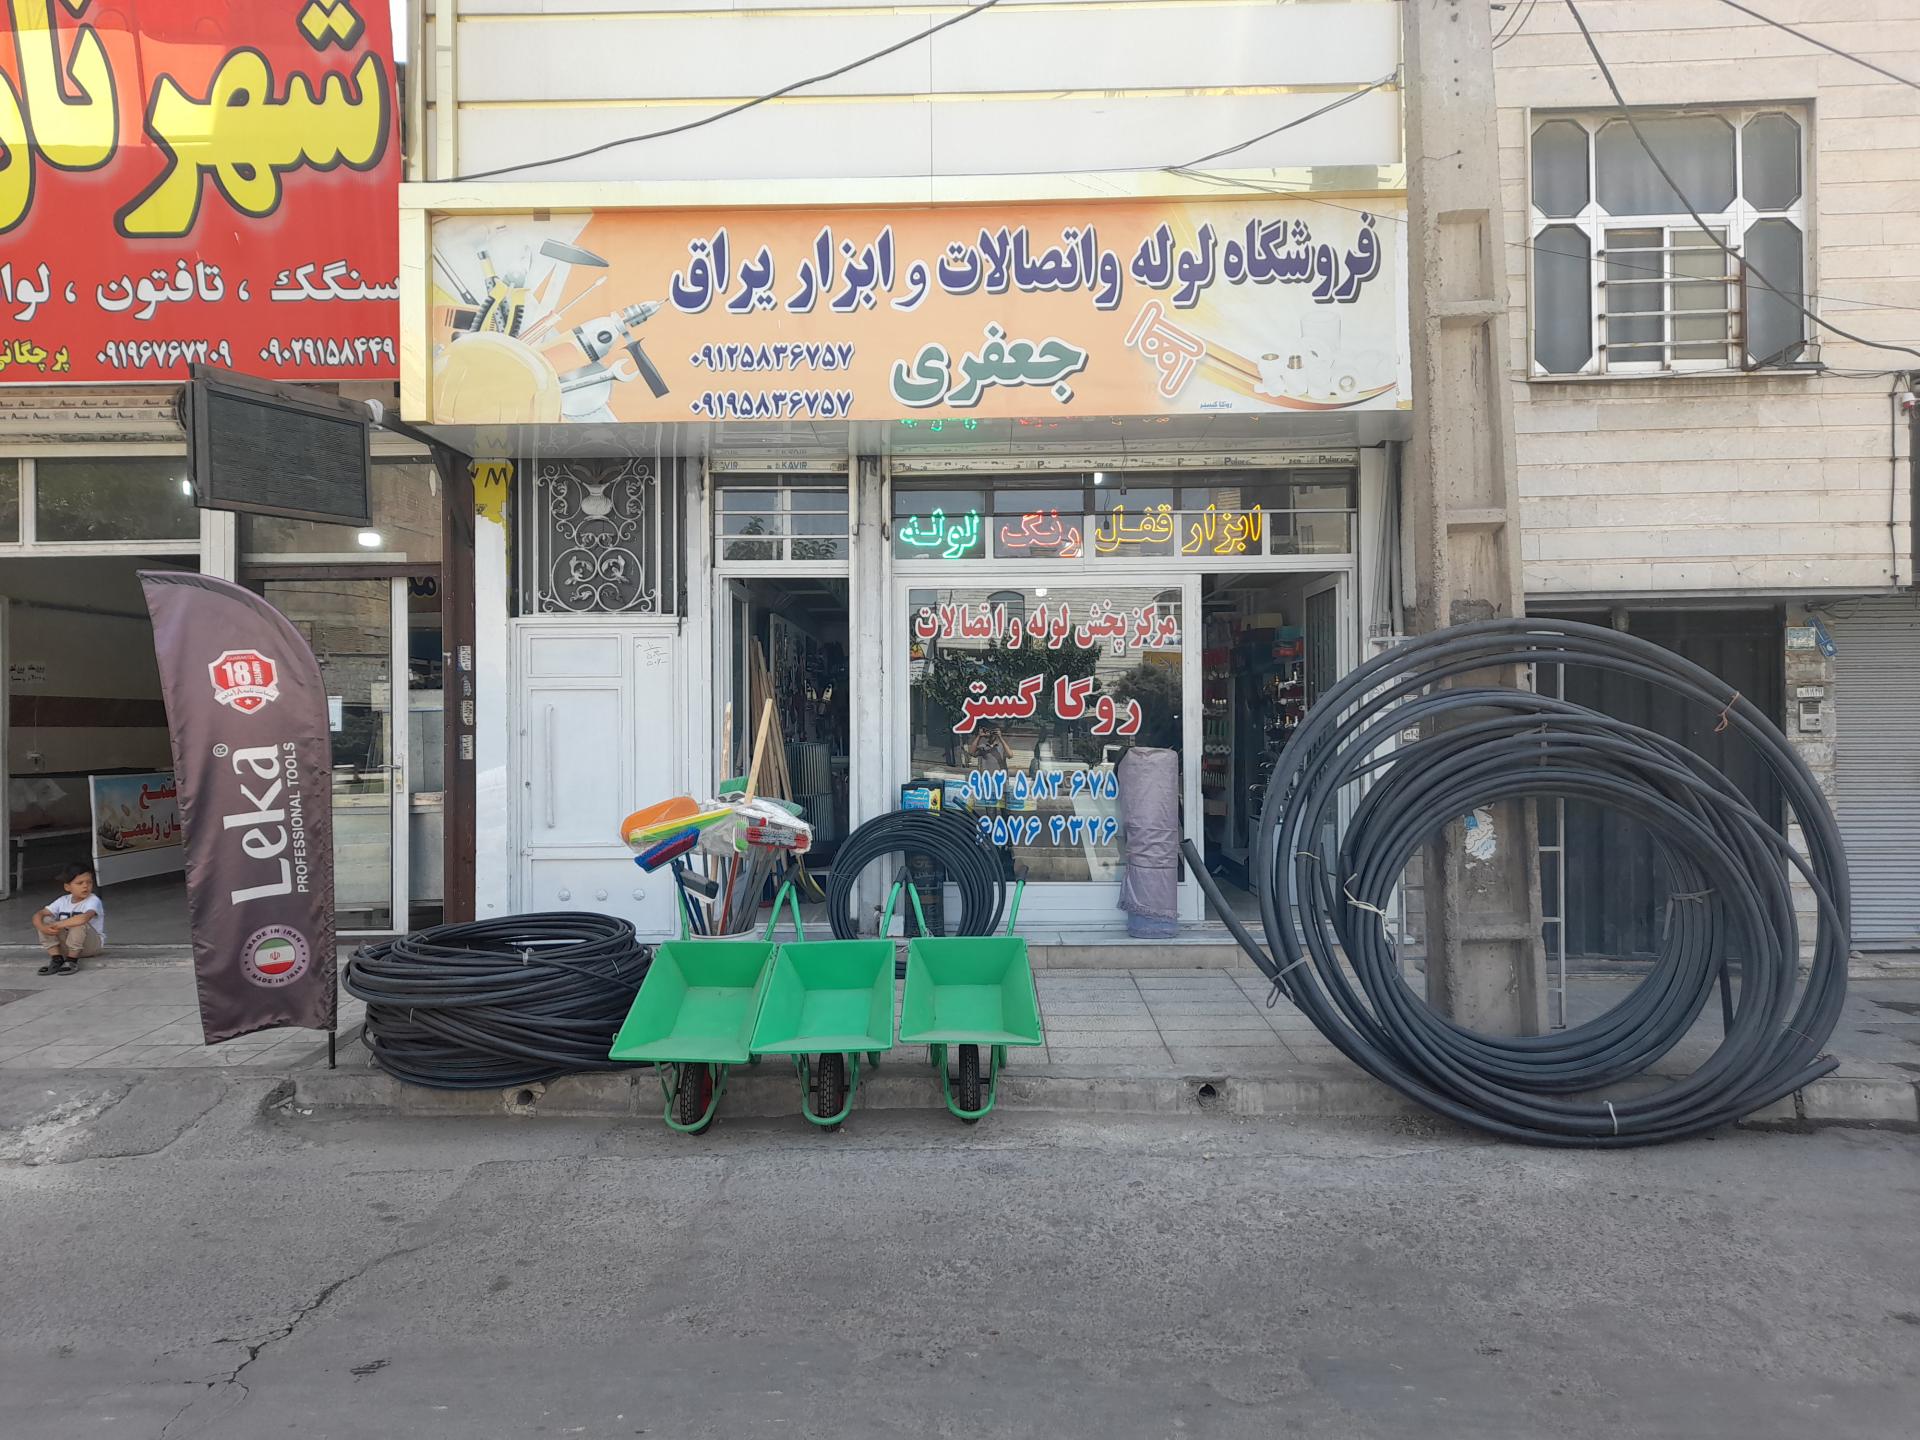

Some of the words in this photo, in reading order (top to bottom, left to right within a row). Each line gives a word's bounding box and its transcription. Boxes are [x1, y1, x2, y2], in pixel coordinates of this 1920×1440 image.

[0, 0, 119, 236] نا
[114, 0, 390, 238] شهر
[670, 227, 777, 313] یراق
[785, 225, 894, 313] ابزار
[1131, 220, 1217, 309] لوله
[1223, 212, 1381, 302] فروشگاه
[0, 261, 51, 321] لوا
[96, 259, 225, 321] تافتون
[96, 339, 232, 369] ۰۹۱۹۶۷۶۷۲۰۹
[260, 336, 396, 366] ۰۹۰۲۹۱۵۸۴۴۹
[689, 343, 854, 371] ۰۹۱۲۵۸۳۶۷۵۷
[889, 320, 1088, 407] جعفری
[689, 390, 853, 419] ۰۹۱۹۵۸۳۶۷۵۷
[782, 461, 808, 470] KAVIR
[900, 508, 979, 558] لوله
[1002, 509, 1081, 558] رنگ
[1095, 504, 1173, 551] قفل
[1181, 504, 1262, 552] ابزار
[1026, 603, 1070, 649] لوله
[1075, 599, 1127, 652] پخش
[1130, 603, 1178, 649] مرکز
[222, 660, 251, 687] 18
[953, 674, 1044, 734] گستر
[283, 742, 299, 787] TOOLS
[960, 769, 1007, 800] ۰۹۱۲
[1013, 769, 1064, 800] ۵۸۳
[223, 744, 292, 905] Leka
[289, 790, 309, 893] PROFESSIONAL
[1048, 814, 1118, 846] ۴۳۲۶
[247, 931, 267, 950] MADE
[282, 928, 302, 943] IRAN
[251, 973, 272, 984] MADE
[286, 965, 303, 980] IRAN
